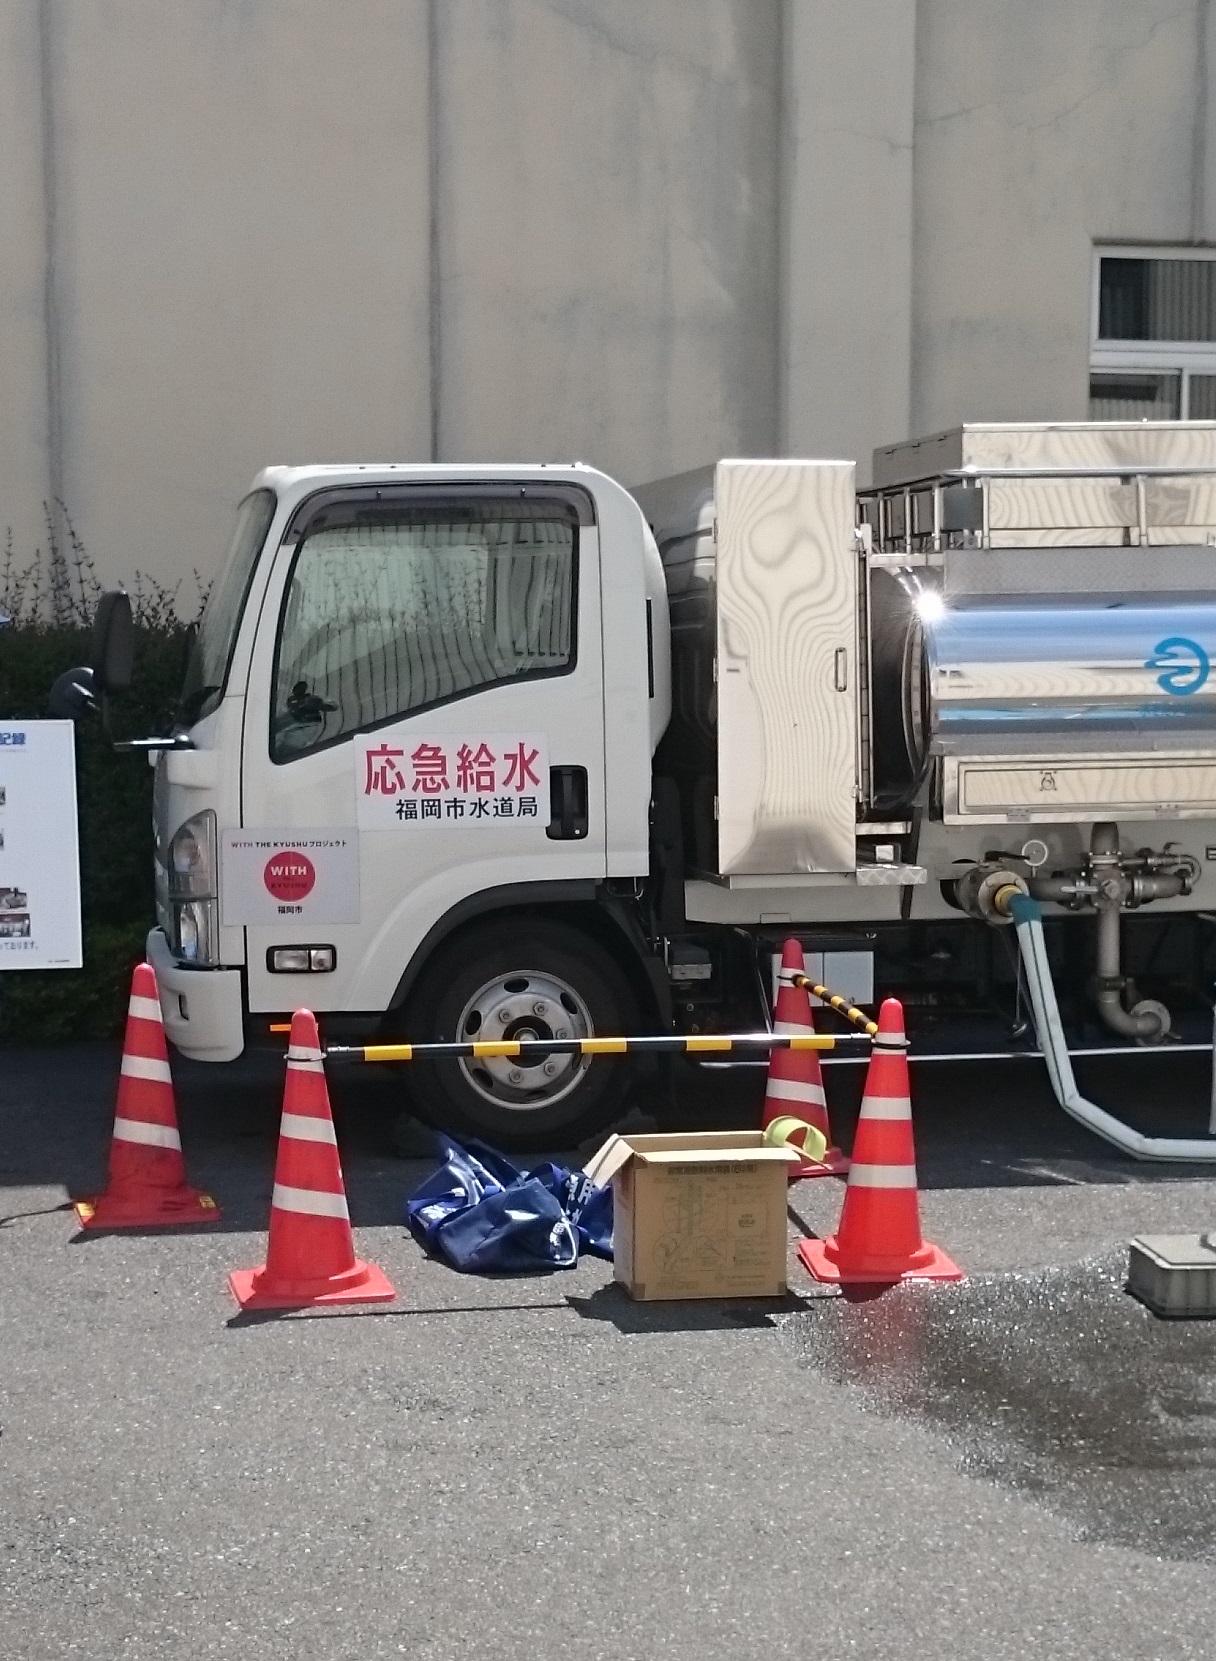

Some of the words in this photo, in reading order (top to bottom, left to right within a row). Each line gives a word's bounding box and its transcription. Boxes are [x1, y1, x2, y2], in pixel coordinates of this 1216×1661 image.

[364, 742, 541, 795] 応急給水
[395, 796, 538, 820] 福岡市水道局
[309, 840, 347, 848] プロジェクト
[271, 866, 307, 876] WITH
[277, 906, 303, 914] 福岡市
